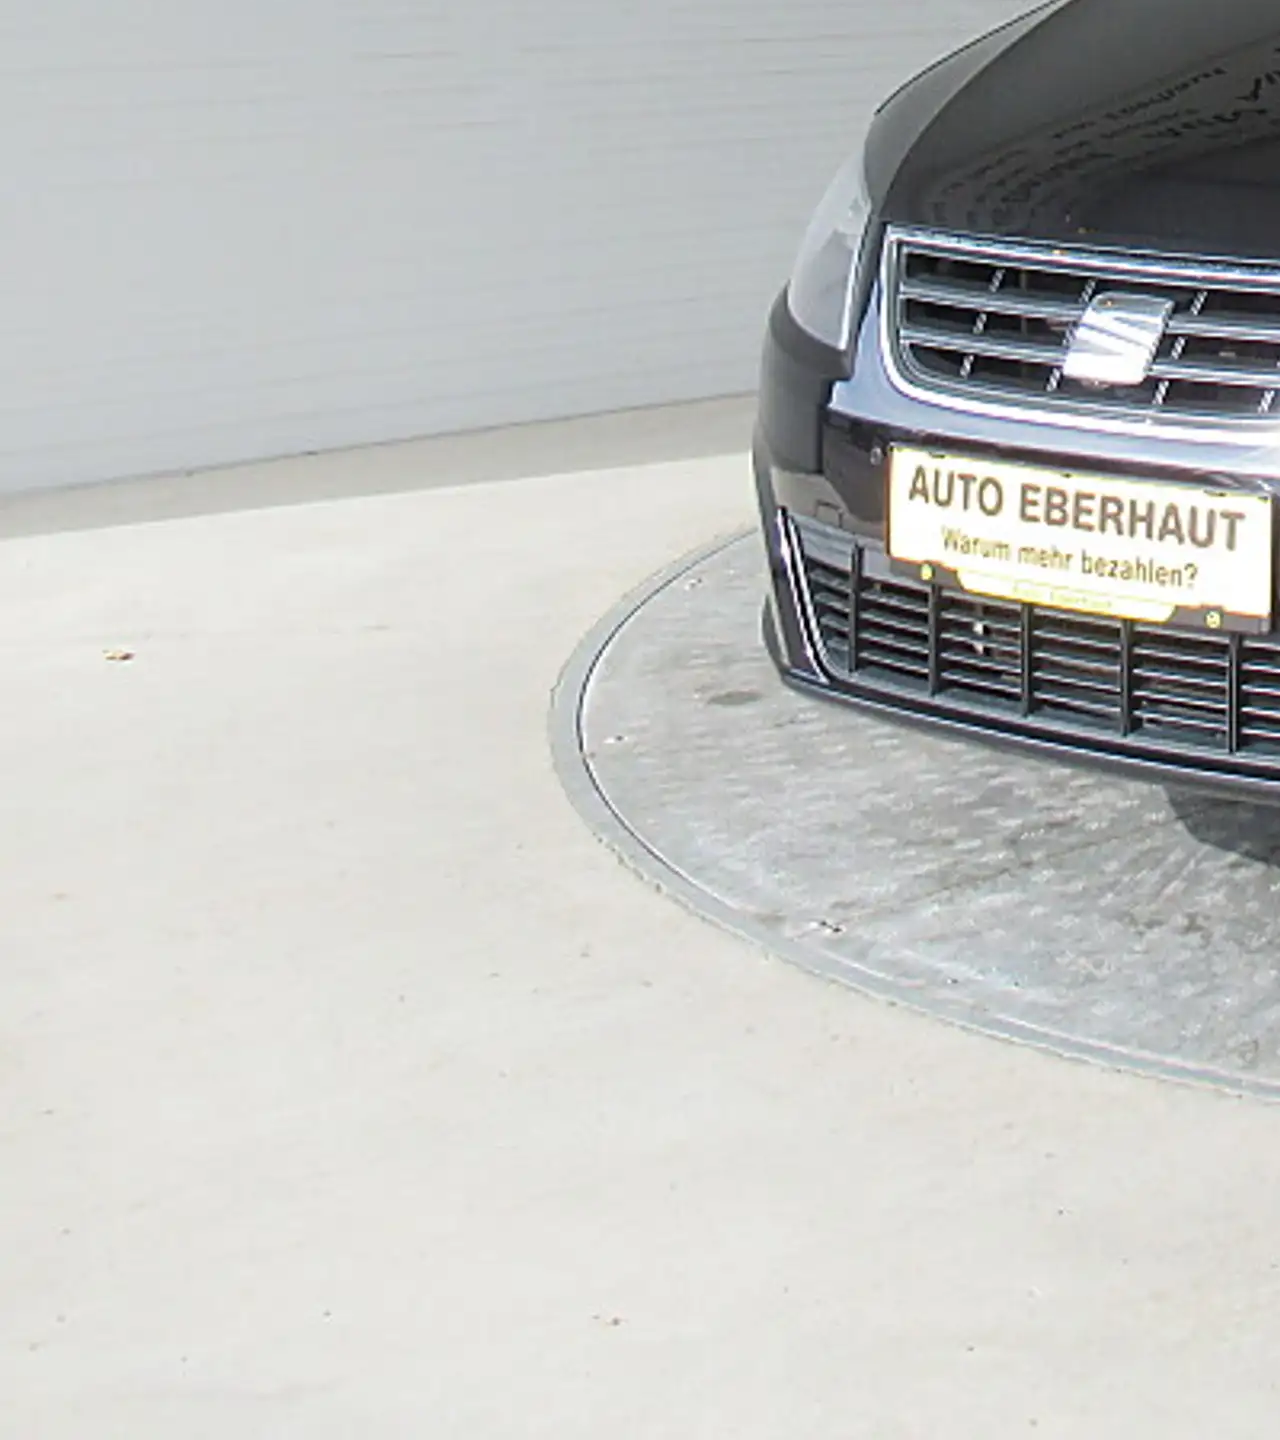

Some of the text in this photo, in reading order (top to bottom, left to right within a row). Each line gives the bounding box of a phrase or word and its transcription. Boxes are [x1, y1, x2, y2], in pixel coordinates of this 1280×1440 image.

[908, 464, 1246, 552] AUTO EBERHAUT
[941, 526, 1198, 589] Warum mehr bezahlen?
